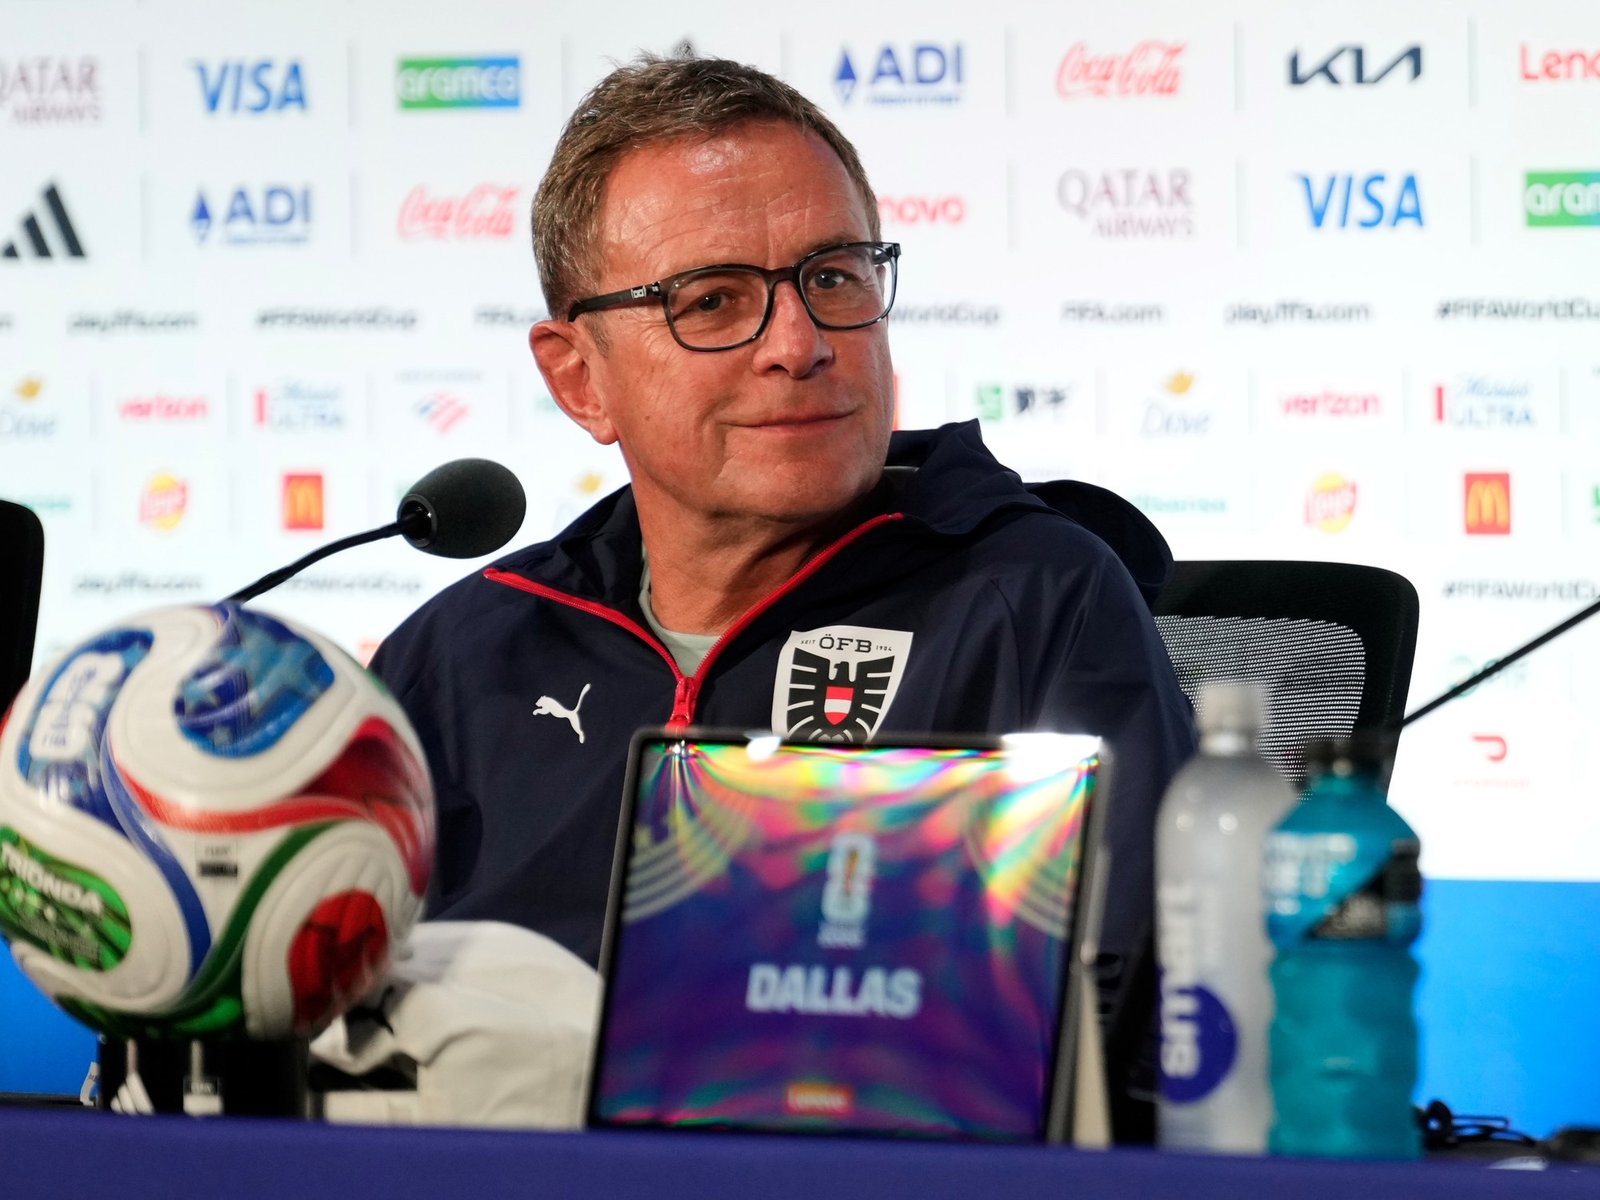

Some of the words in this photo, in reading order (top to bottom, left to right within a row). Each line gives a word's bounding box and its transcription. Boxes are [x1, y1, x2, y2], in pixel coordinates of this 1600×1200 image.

[399, 67, 520, 97] aramco
[871, 45, 964, 85] ADI
[194, 60, 308, 113] VISA
[225, 186, 311, 227] ADI
[1057, 168, 1193, 217] QATAR
[1299, 174, 1424, 228] VISA
[1094, 215, 1194, 238] AIRWAYS
[119, 396, 209, 420] verizon
[1279, 390, 1382, 417] verizon
[819, 633, 872, 653] ÖFB
[875, 644, 893, 652] 1904
[745, 962, 923, 1019] DALLAS
